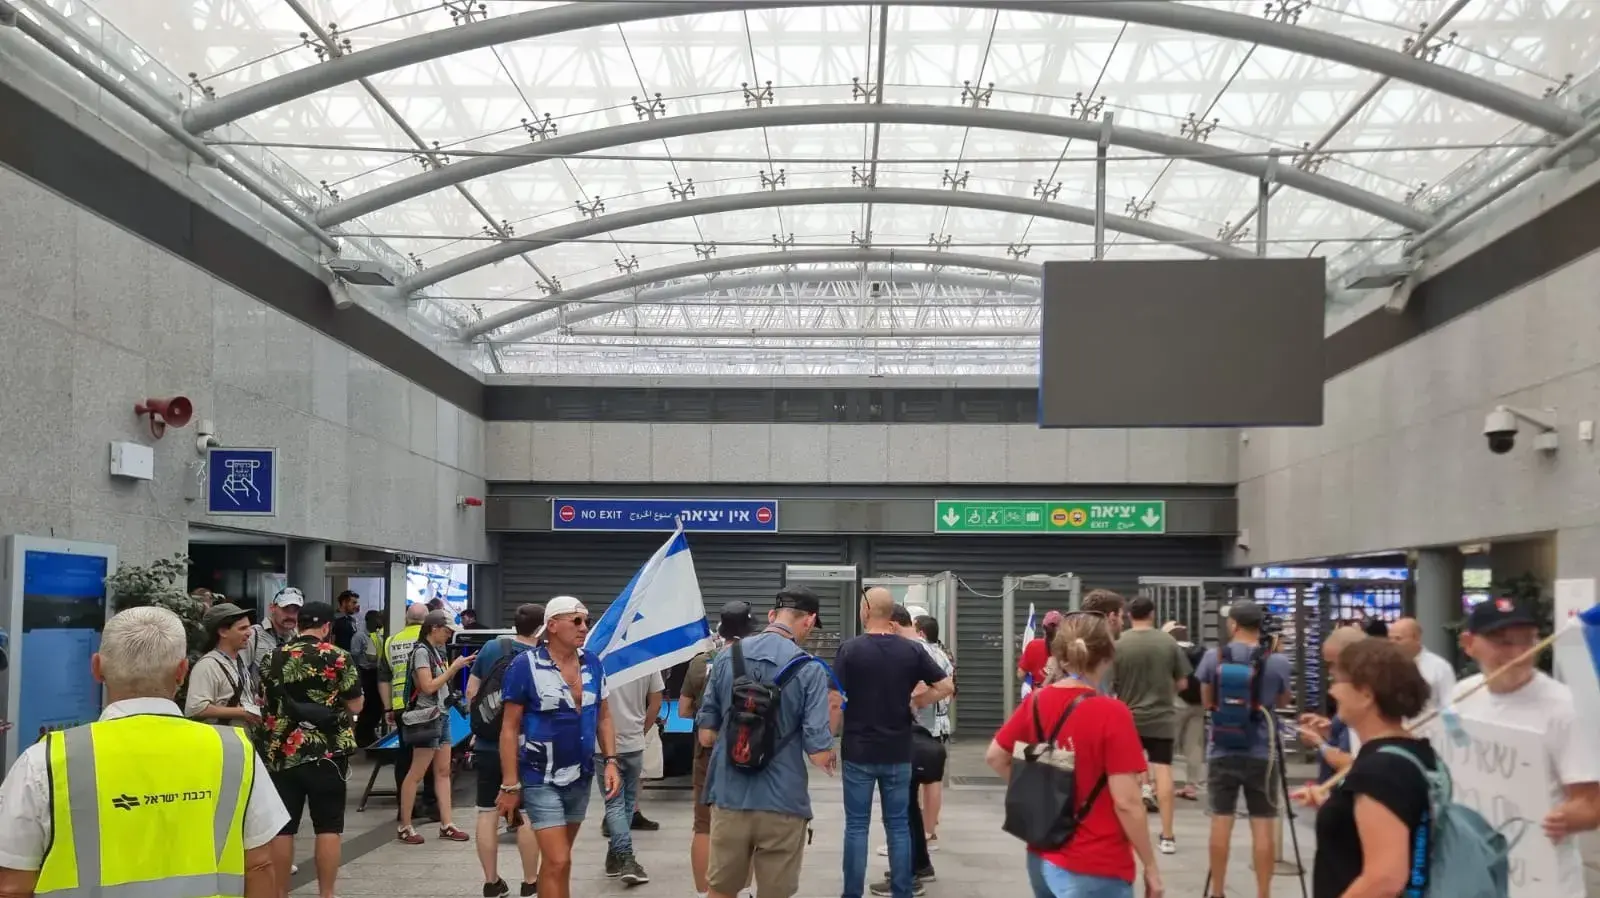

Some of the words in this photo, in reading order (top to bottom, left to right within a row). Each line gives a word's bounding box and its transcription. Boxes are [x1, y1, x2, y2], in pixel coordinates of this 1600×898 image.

[581, 510, 596, 519] NO
[599, 510, 623, 519] EXIT
[681, 510, 724, 522] יציאה
[729, 510, 750, 523] אין
[1090, 505, 1136, 518] יציאה
[1090, 521, 1110, 529] EXIT
[143, 793, 179, 805] ישראל
[182, 790, 212, 801] רכבת
